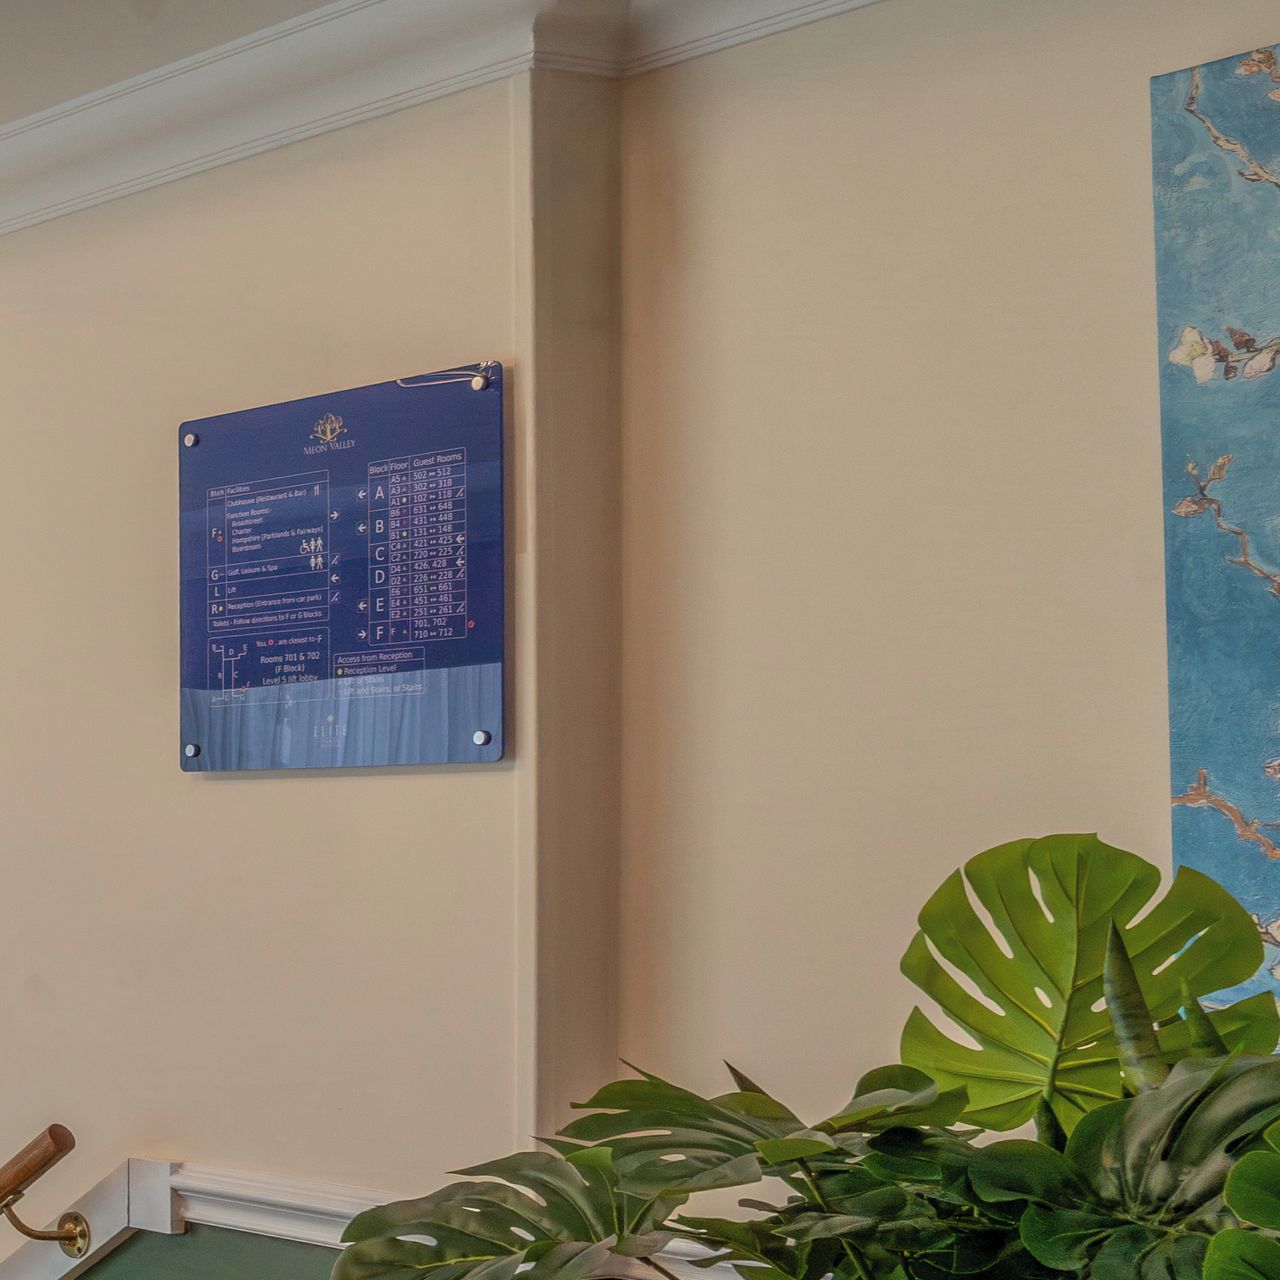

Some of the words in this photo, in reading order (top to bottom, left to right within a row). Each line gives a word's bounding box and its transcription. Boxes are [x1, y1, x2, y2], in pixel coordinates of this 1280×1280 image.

[304, 444, 327, 455] MEON
[329, 440, 355, 450] VALLEY
[369, 465, 389, 474] Block
[390, 462, 408, 470] Floor
[413, 457, 435, 467] Guest
[436, 453, 462, 463] Rooms
[390, 475, 400, 483] A5
[413, 471, 427, 480] 502
[437, 467, 451, 476] 512
[375, 486, 385, 500] A
[390, 486, 400, 495] A3
[413, 483, 427, 492] 302
[437, 479, 452, 488] 318
[390, 498, 400, 506] A1
[413, 494, 427, 503] 102
[438, 490, 452, 499] 118
[390, 509, 400, 517] B6
[413, 505, 427, 514] 631
[437, 501, 452, 510] 648
[376, 519, 384, 533] B
[390, 521, 400, 529] B4
[413, 516, 427, 525] 431
[437, 513, 452, 521] 448
[211, 528, 217, 538] F
[413, 528, 427, 537] 131
[439, 524, 453, 533] 148
[414, 539, 428, 547] 421
[438, 536, 452, 544] 425
[375, 547, 385, 560] C
[390, 553, 400, 561] C2
[414, 550, 428, 559] 220
[438, 547, 452, 556] 225
[432, 560, 447, 568] 428
[211, 569, 218, 580] G
[267, 564, 278, 572] Spa
[375, 570, 385, 583] D
[390, 576, 400, 585] D2
[414, 574, 428, 582] 226
[438, 571, 453, 579] 228
[214, 586, 220, 597] L
[414, 585, 428, 593] 651
[438, 582, 452, 591] 661
[376, 598, 384, 612] E
[414, 596, 428, 605] 451
[438, 593, 452, 602] 461
[211, 604, 218, 614] R
[228, 601, 254, 610] Reception
[303, 610, 322, 618] Blocks
[391, 611, 400, 619] E2
[414, 608, 428, 617] 251
[438, 605, 452, 614] 261
[432, 617, 446, 626] 702
[376, 626, 384, 640] F
[391, 627, 396, 636] F
[414, 630, 428, 639] 710
[439, 627, 453, 636] 712
[260, 656, 283, 664] Rooms
[285, 653, 297, 662] 701
[307, 651, 320, 660] 702
[337, 656, 360, 664] Access
[361, 654, 377, 662] from
[379, 651, 413, 661] Reception
[344, 665, 377, 675] Reception
[379, 664, 397, 672] Level
[262, 677, 280, 685] Level
